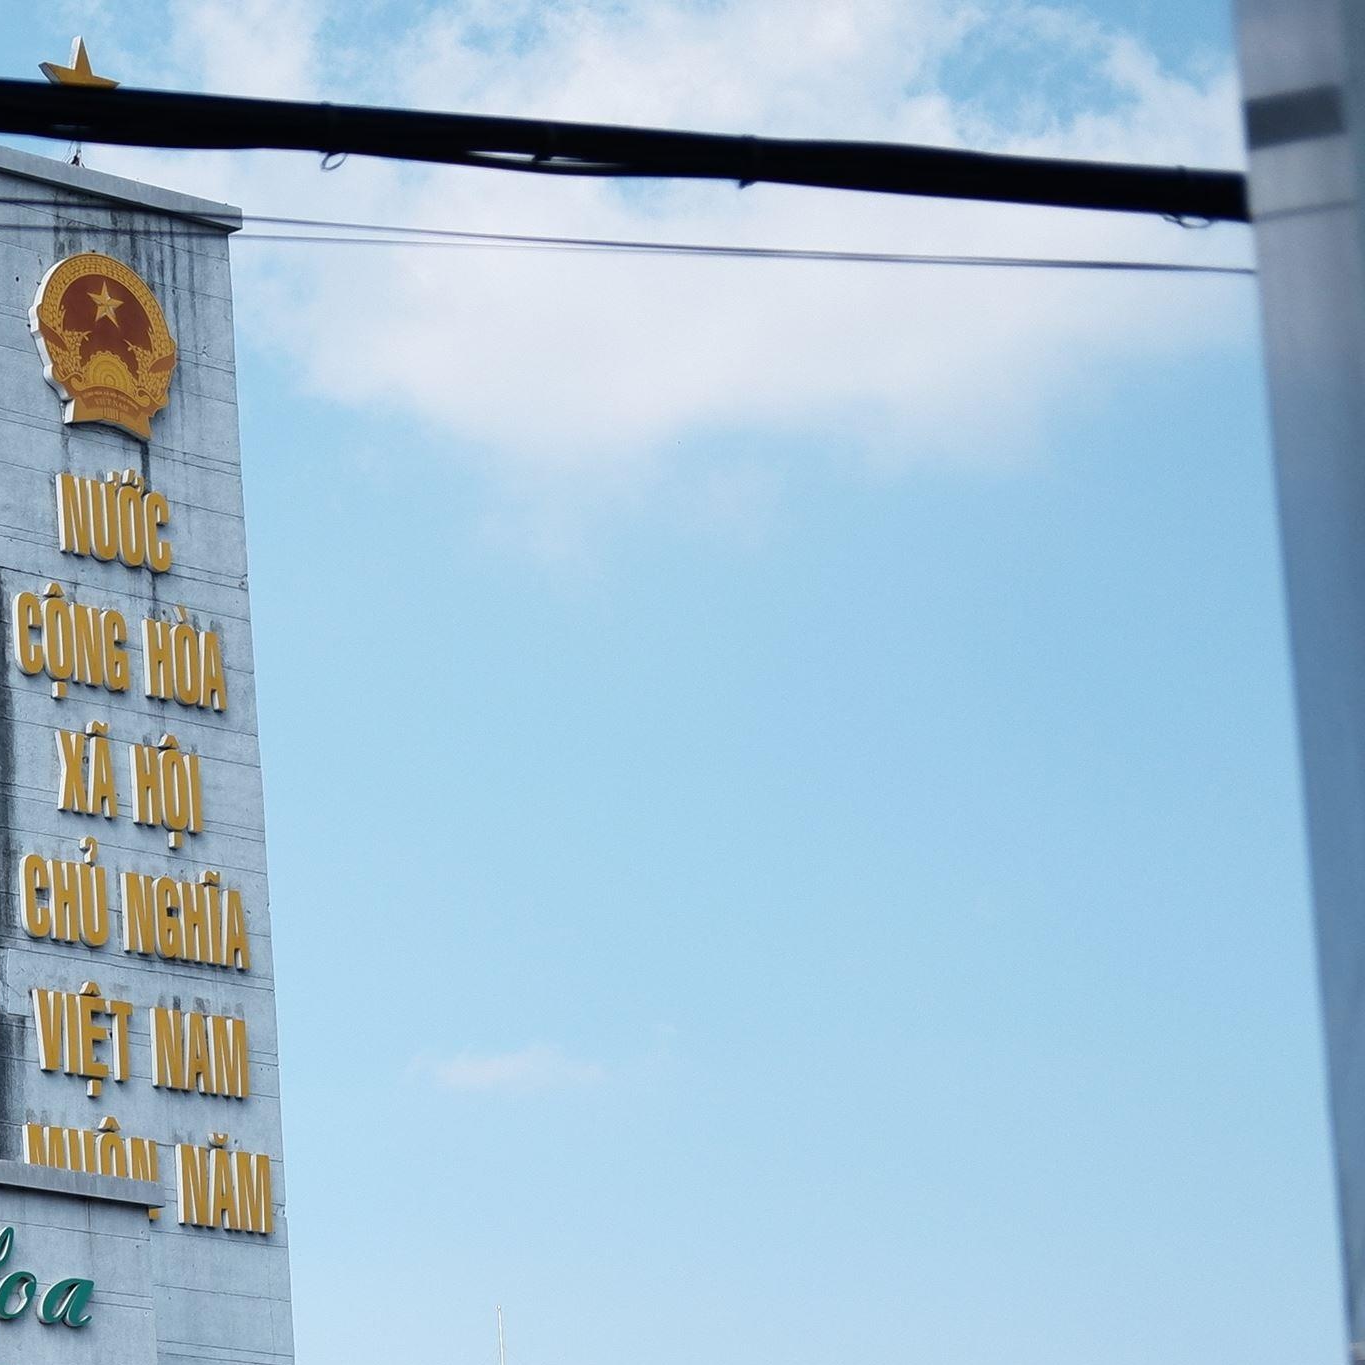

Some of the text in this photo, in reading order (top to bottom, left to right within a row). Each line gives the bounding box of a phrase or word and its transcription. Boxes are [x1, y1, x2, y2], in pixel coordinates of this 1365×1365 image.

[56, 469, 171, 572] NƯỚC
[14, 583, 227, 711] CỘNG HÒA
[55, 721, 203, 849] XÃ HỘI
[19, 838, 251, 970] CHỦ NGHĨA
[30, 981, 251, 1099] VIỆT NAM
[175, 1133, 273, 1234] NĂM
